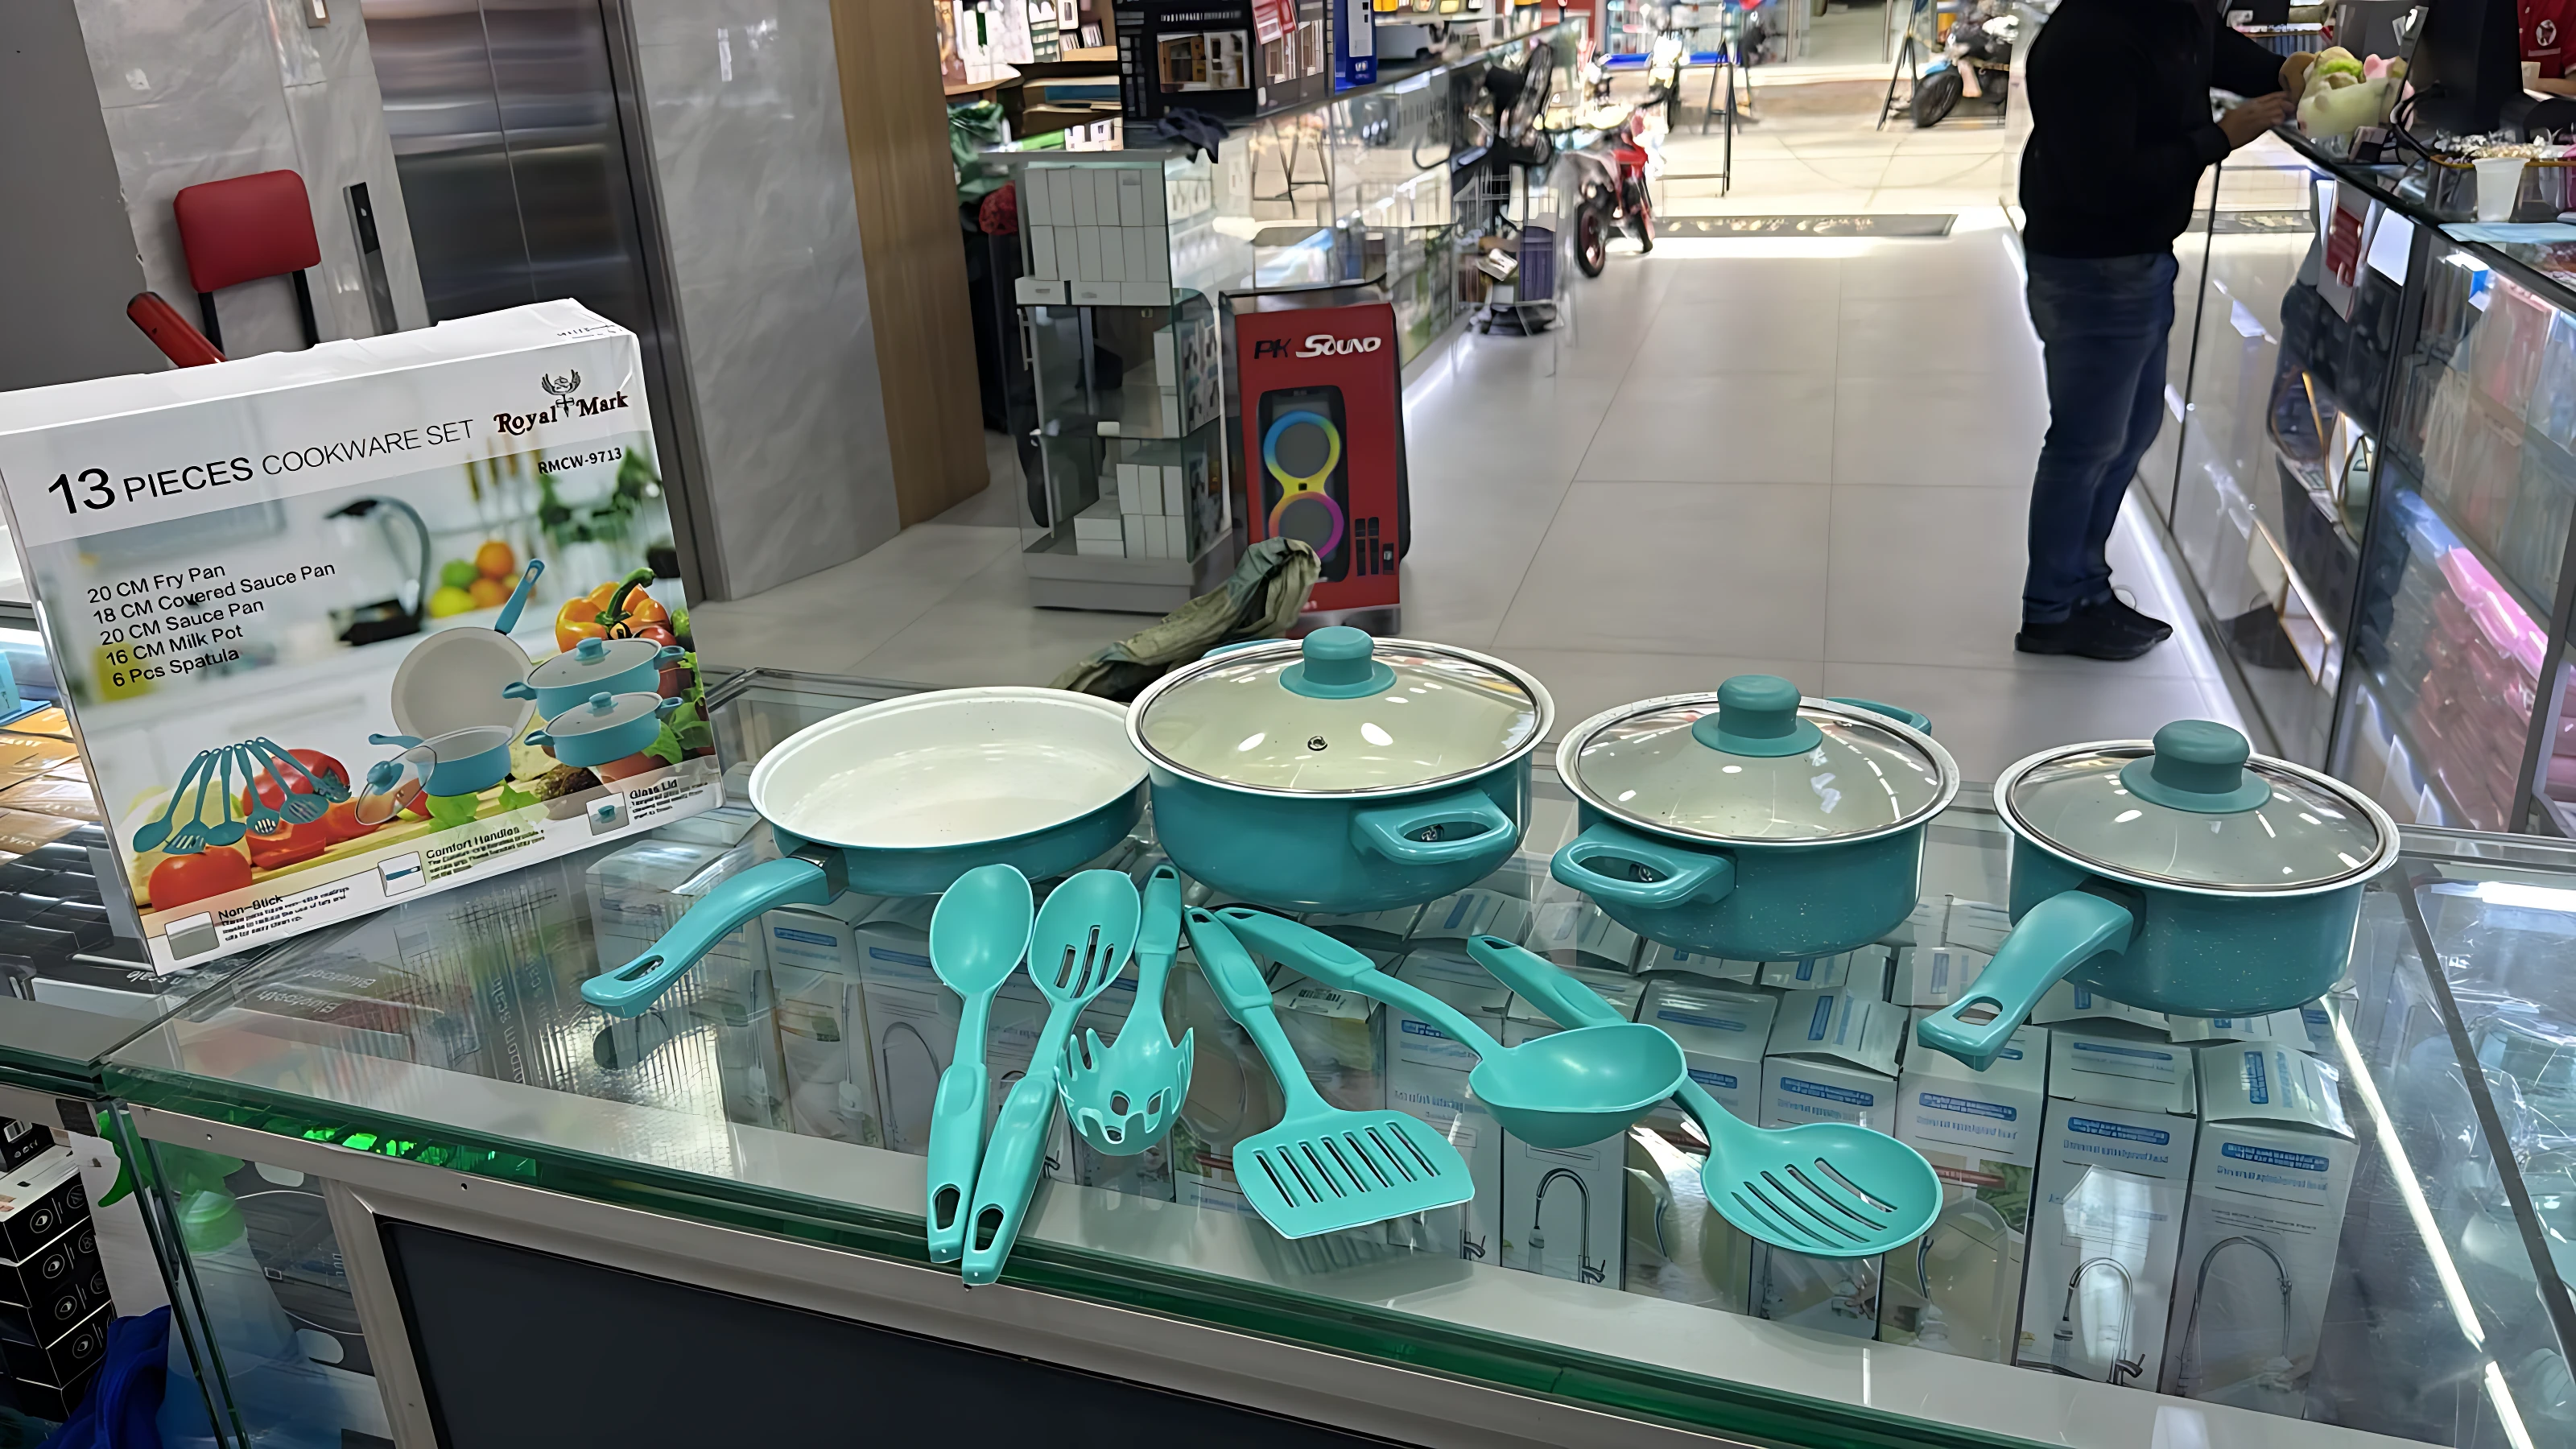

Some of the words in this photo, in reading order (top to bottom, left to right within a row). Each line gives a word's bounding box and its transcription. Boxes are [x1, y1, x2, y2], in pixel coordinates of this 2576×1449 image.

[1253, 338, 1292, 360] PK
[493, 405, 558, 436] Royal
[576, 390, 630, 417] Mark
[47, 468, 115, 514] 13
[123, 456, 254, 502] PIECES
[262, 429, 422, 475] COOKWARE
[426, 419, 473, 445] SET
[538, 447, 622, 475] RMCW-9713
[87, 585, 112, 604] 20
[116, 577, 150, 597] CM
[153, 573, 184, 589] Fry
[188, 565, 226, 583] Pan
[93, 608, 117, 625] 18
[121, 599, 154, 619] CM
[158, 581, 237, 610] Covered
[240, 572, 297, 593] Sauce
[300, 564, 336, 580] Pan
[100, 628, 125, 646] 20
[129, 619, 161, 639] CM
[165, 609, 225, 631] Sauce
[228, 601, 264, 617] Pan
[105, 649, 129, 667] 16
[133, 641, 166, 660] CM
[168, 632, 209, 653] Milk
[211, 624, 244, 643] Pot
[112, 671, 126, 687] 6
[129, 666, 166, 683] Pcs
[169, 647, 240, 675] Spatula
